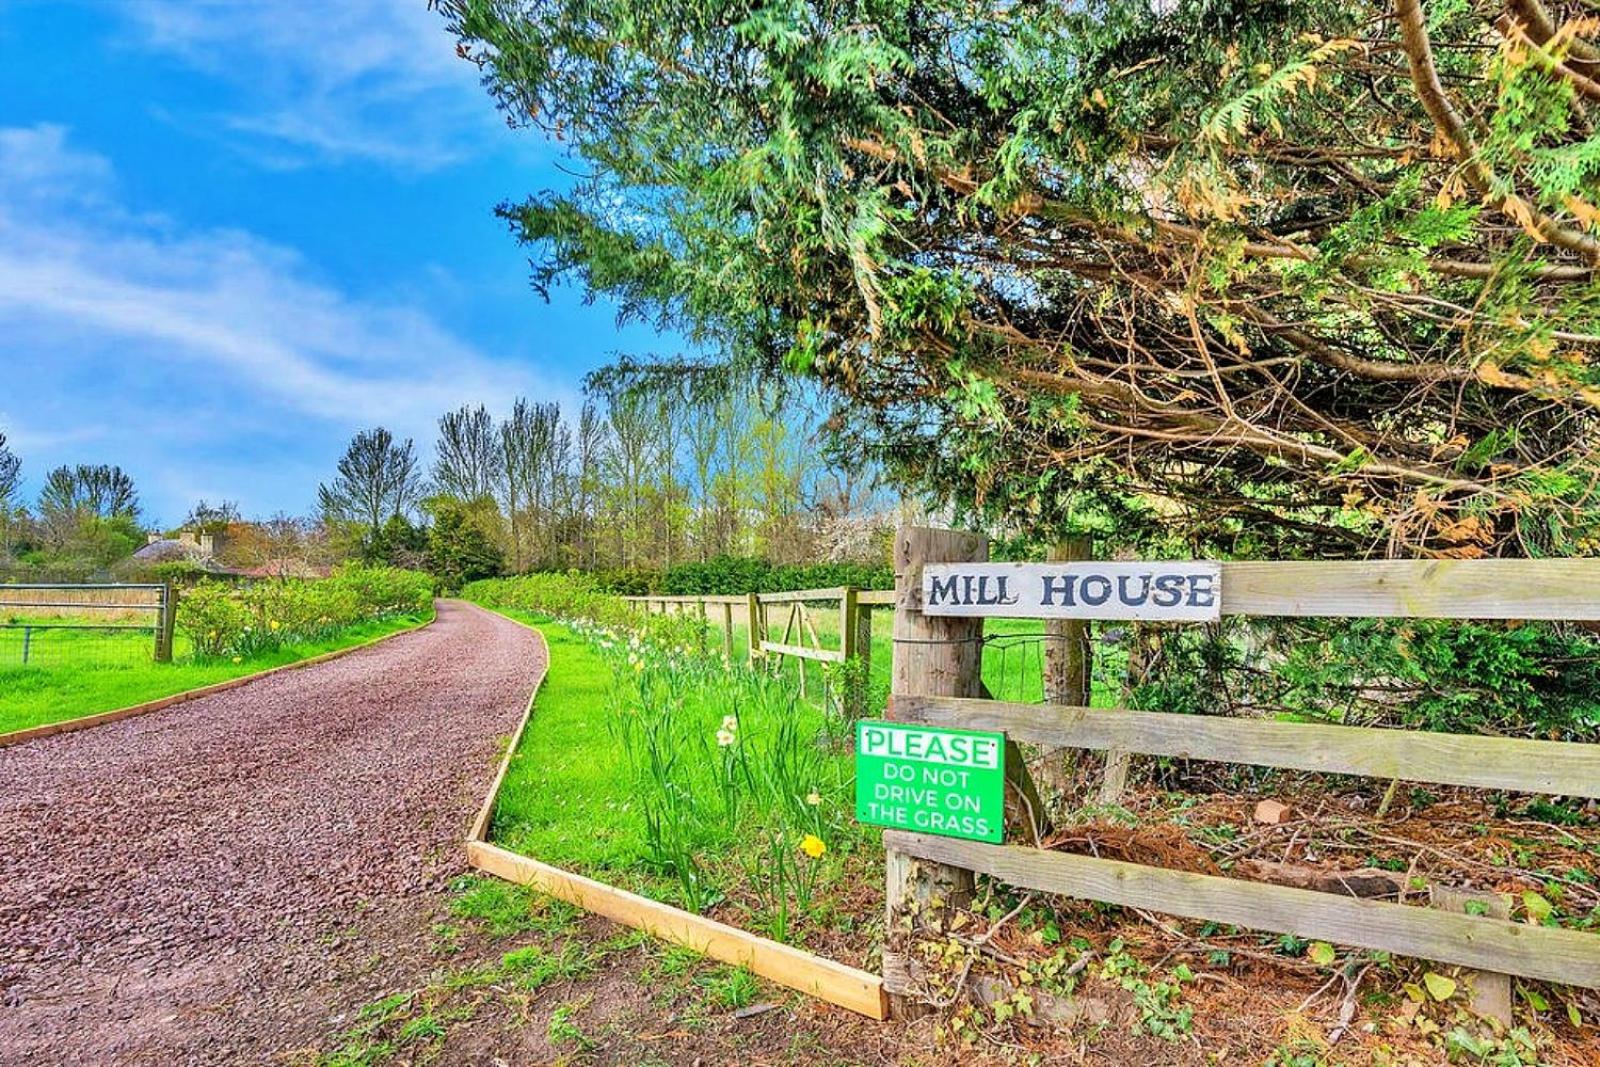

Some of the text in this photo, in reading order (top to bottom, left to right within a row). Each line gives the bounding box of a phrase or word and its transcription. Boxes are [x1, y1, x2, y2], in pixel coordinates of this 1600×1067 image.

[929, 573, 1216, 607] MILL HOUSE
[868, 729, 990, 766] PLEASE
[883, 763, 970, 789] DO NOT
[874, 784, 981, 813] DRIVE ON
[867, 802, 988, 836] THE GRASS
